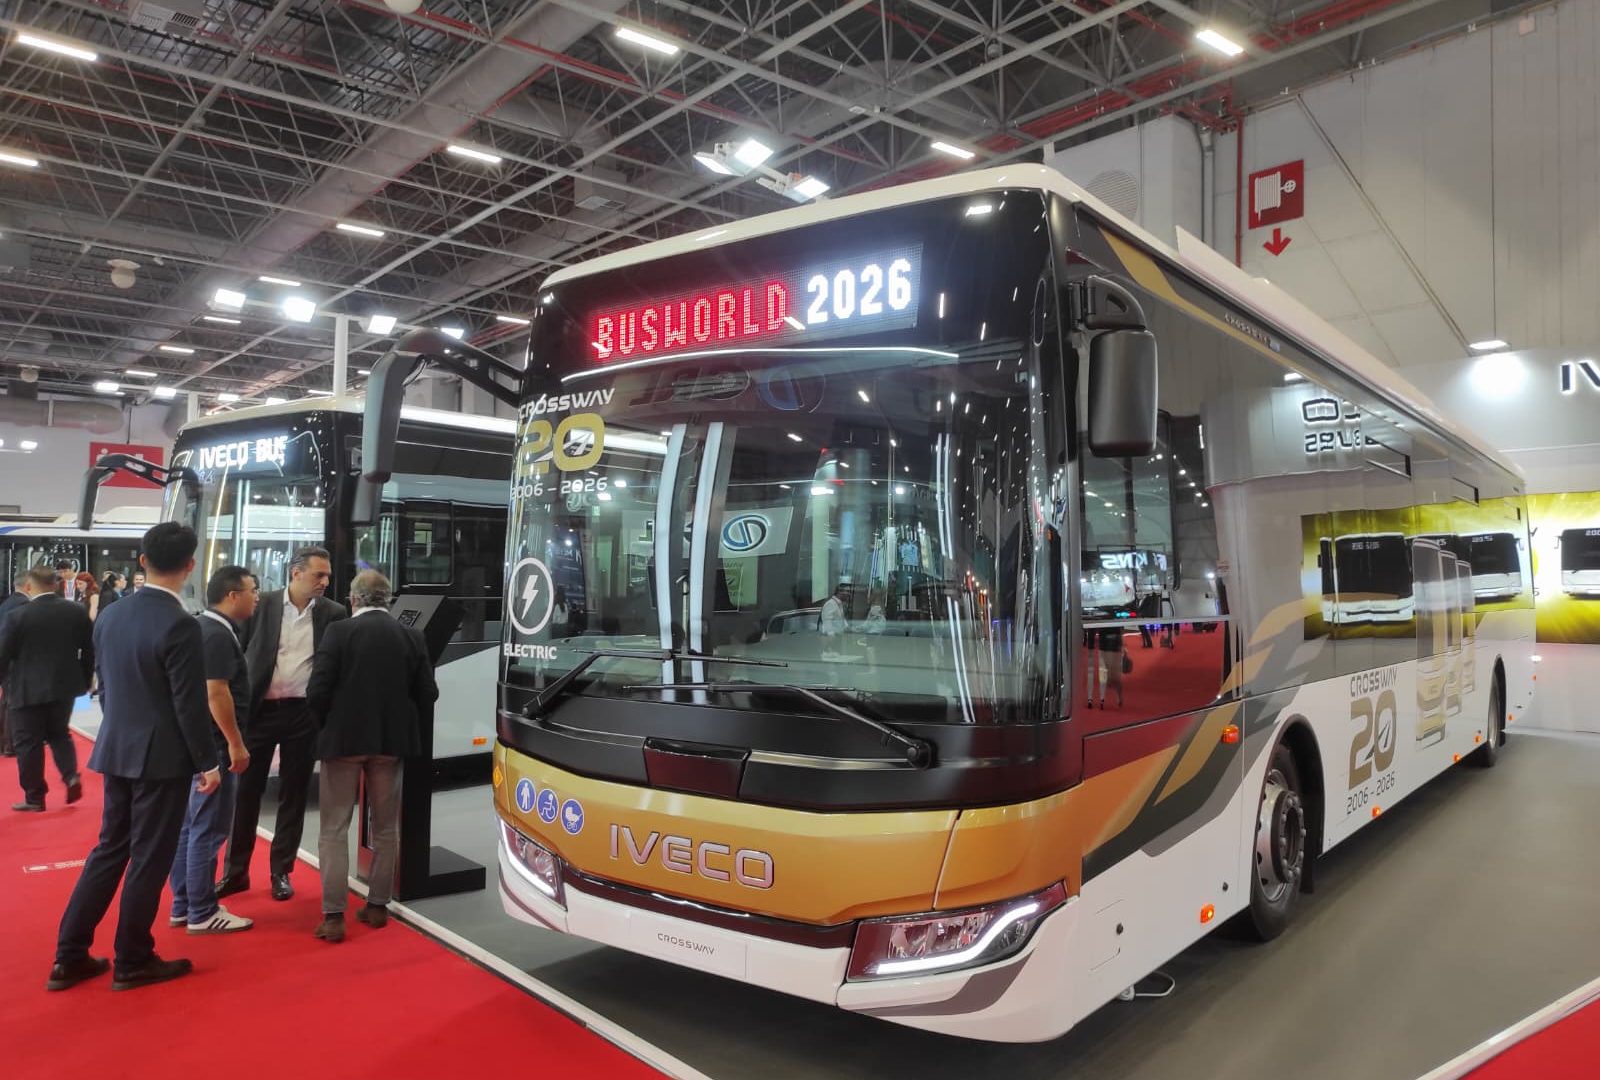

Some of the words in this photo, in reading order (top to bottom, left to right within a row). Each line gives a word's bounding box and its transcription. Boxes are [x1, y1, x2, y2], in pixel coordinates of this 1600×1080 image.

[598, 282, 787, 359] BUSWORLD
[806, 257, 912, 325] 2026
[519, 387, 616, 420] CROSSWAY
[199, 441, 249, 470] IVECO
[518, 412, 605, 477] 20
[561, 477, 608, 494] 2026
[503, 642, 558, 660] ELECTRIC
[1350, 667, 1398, 697] CROSSWAY
[1348, 689, 1397, 790] 20
[1347, 786, 1369, 815] 2006
[1376, 771, 1396, 797] 2026
[609, 822, 775, 890] IVECO
[656, 932, 715, 956] CROSSWAY
